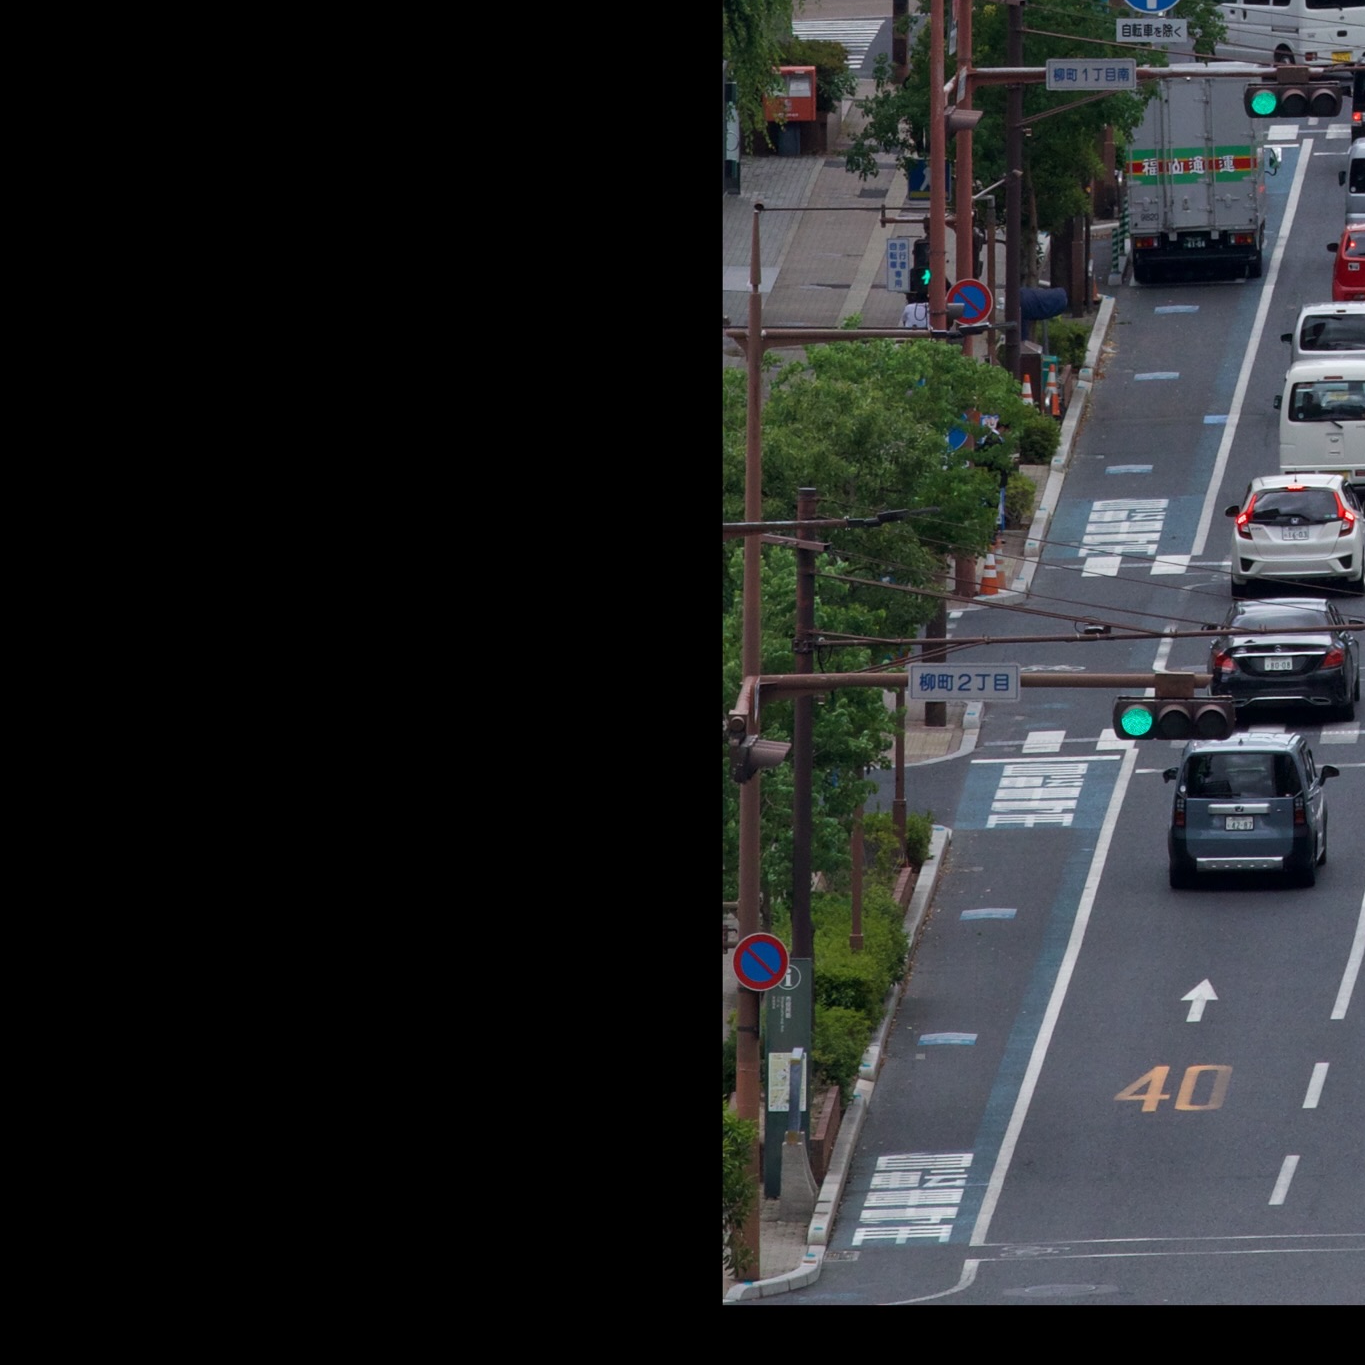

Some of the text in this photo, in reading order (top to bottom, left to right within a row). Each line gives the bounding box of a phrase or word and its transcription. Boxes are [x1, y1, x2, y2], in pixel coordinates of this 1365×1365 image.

[1121, 24, 1183, 38] 自転車を除く
[1053, 66, 1130, 83] 柳町1丁目南
[1141, 156, 1235, 176] 福山通運
[918, 673, 1010, 692] 柳町2丁目
[1114, 1064, 1233, 1113] 40
